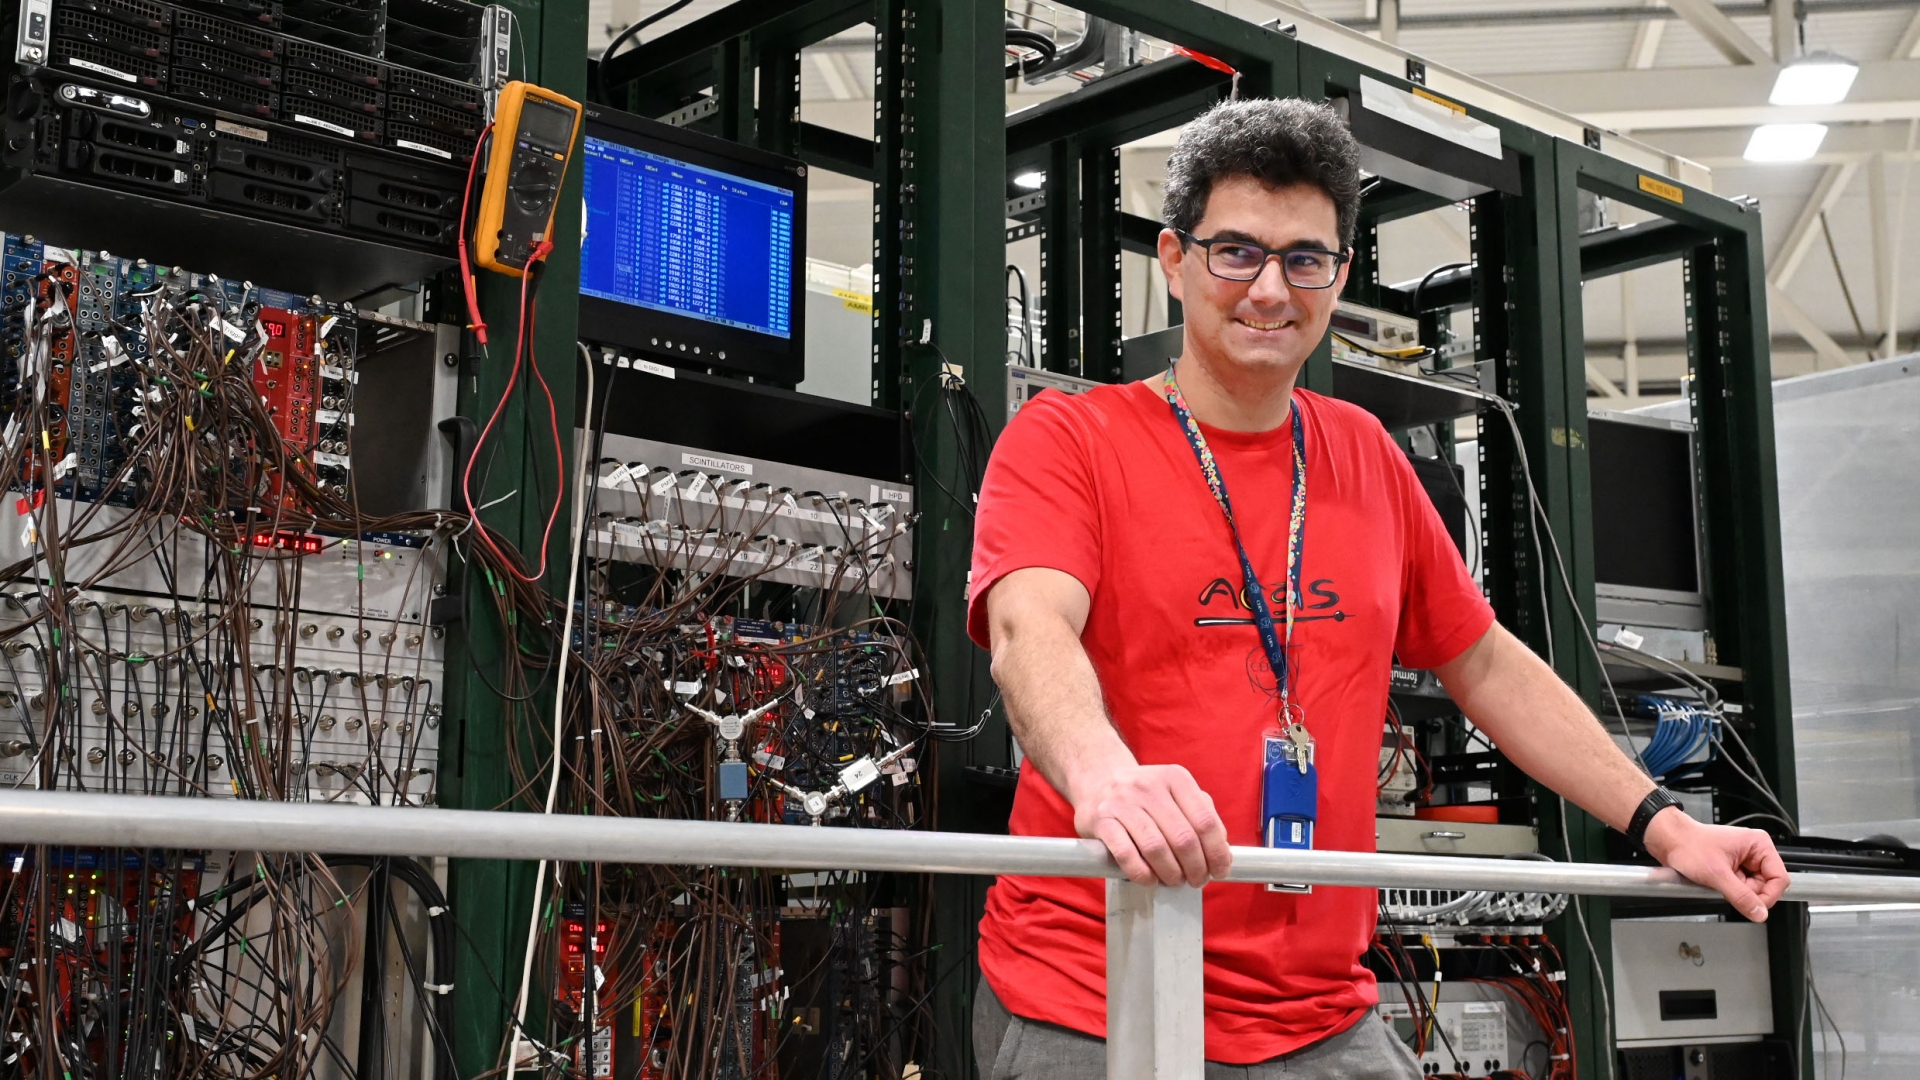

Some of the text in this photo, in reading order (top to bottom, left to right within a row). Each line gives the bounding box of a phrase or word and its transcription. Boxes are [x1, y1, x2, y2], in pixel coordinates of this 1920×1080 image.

[689, 456, 746, 473] SCINTILLATORS
[888, 492, 902, 500] HPD
[854, 569, 862, 577] 24
[1390, 670, 1418, 684] formul
